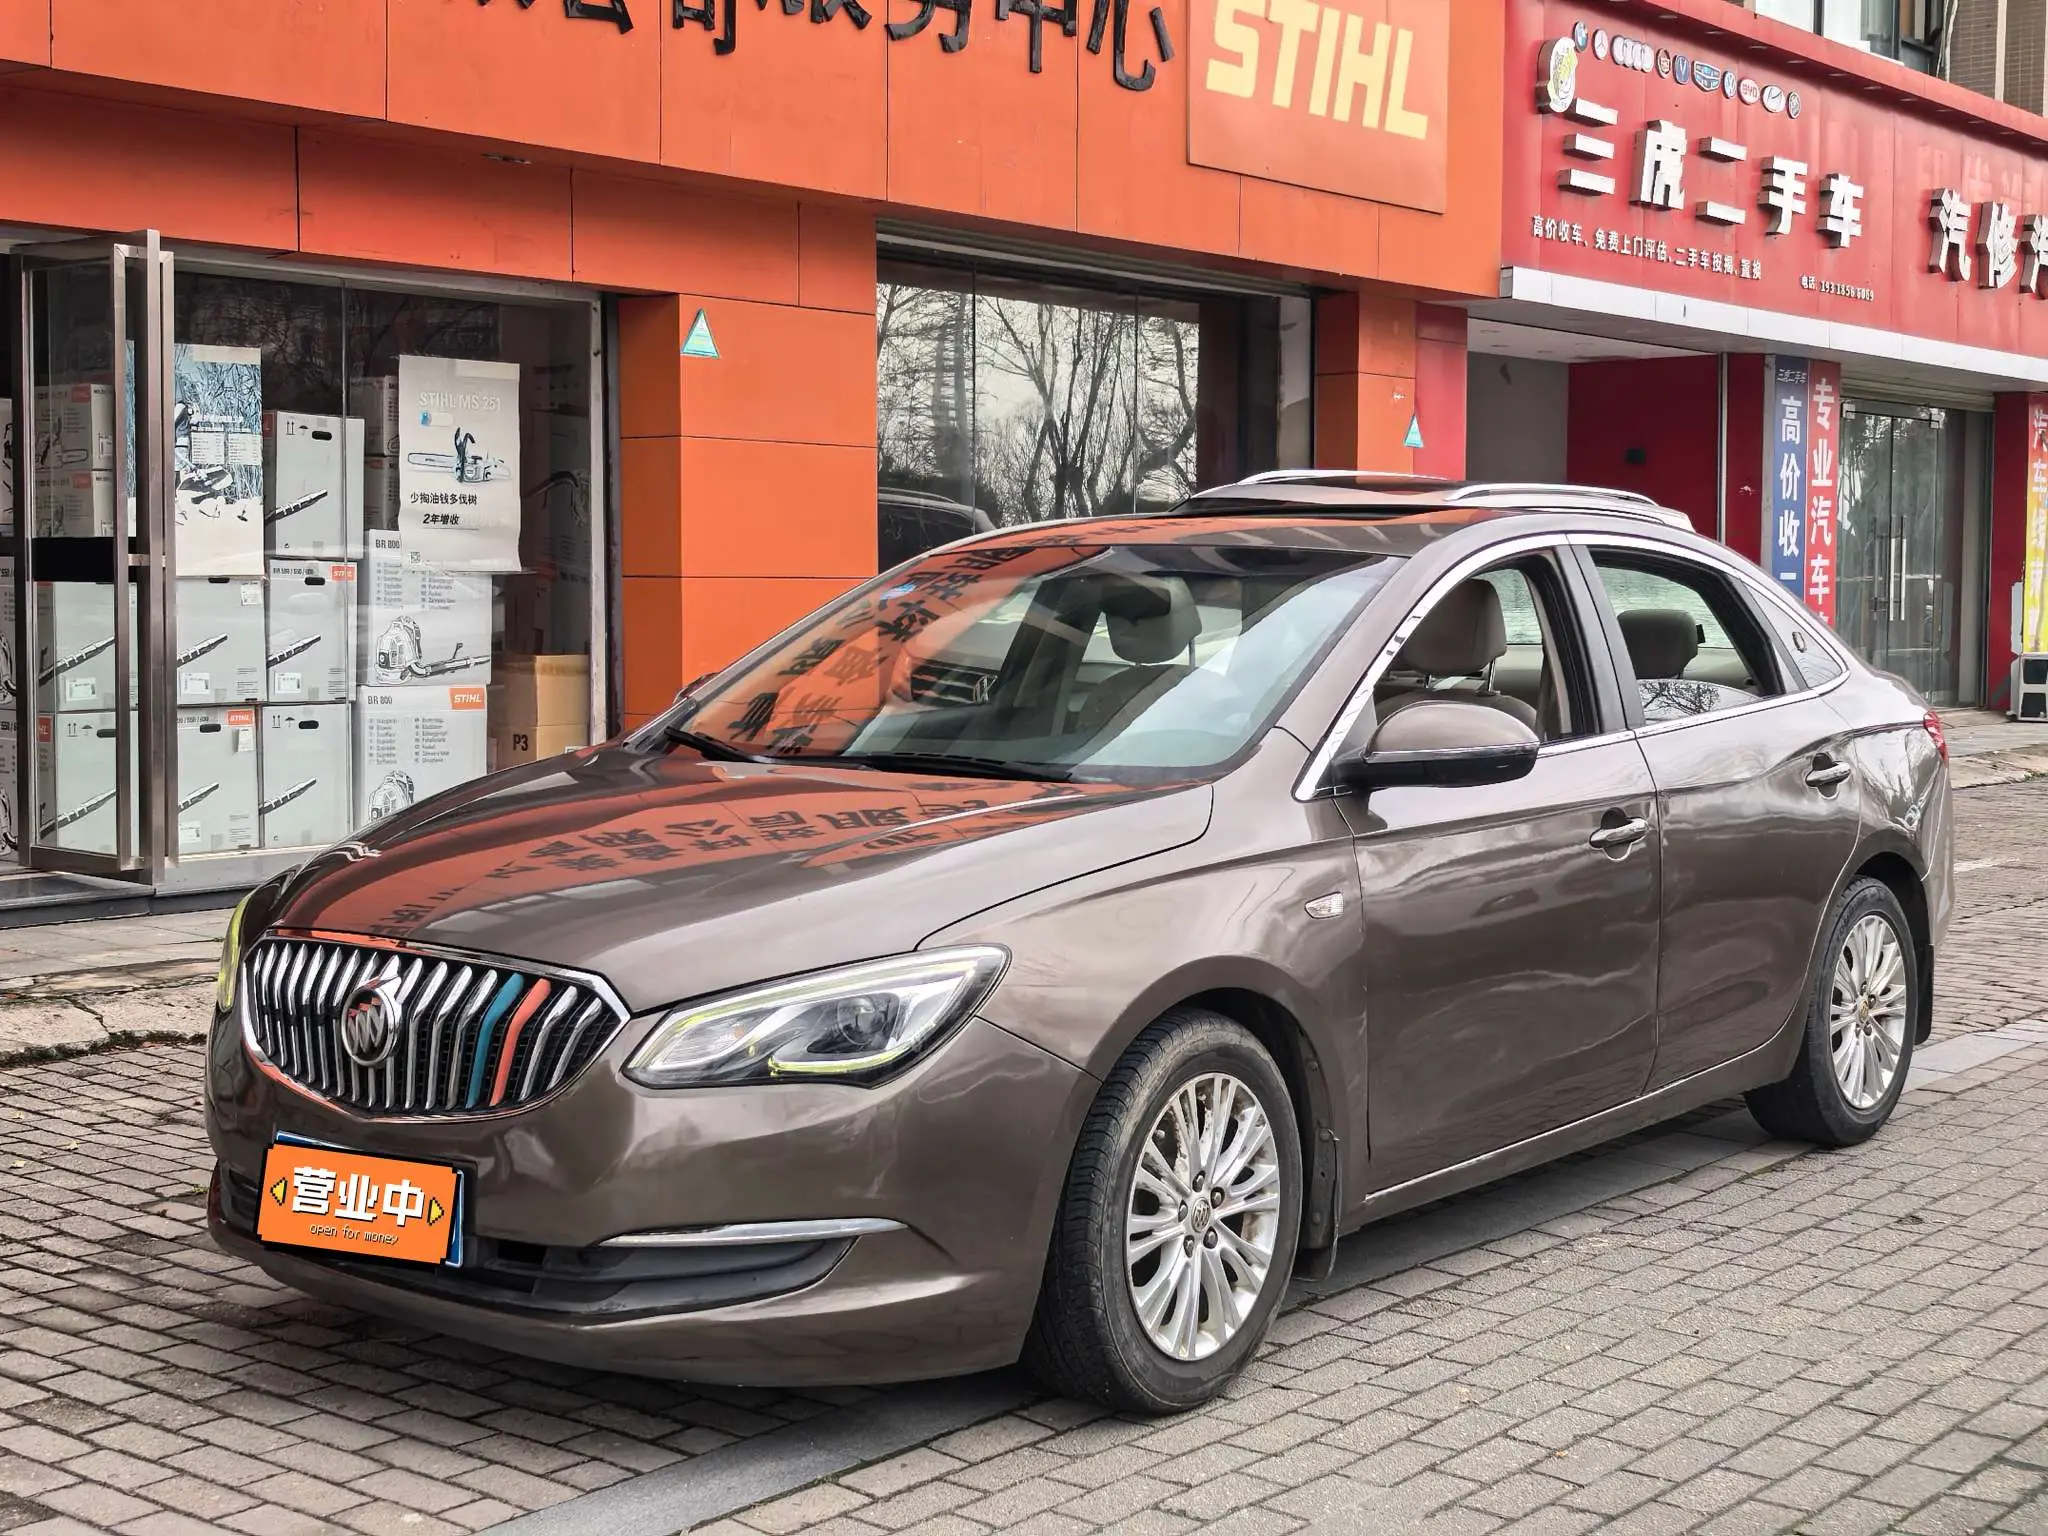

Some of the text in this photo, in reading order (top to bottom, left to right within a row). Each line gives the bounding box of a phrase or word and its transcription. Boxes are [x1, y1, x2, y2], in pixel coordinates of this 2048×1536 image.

[1206, 0, 1428, 140] STIHL
[1560, 97, 1864, 248] 三虎二手车
[419, 391, 457, 408] STIHL
[459, 394, 480, 410] MS
[410, 491, 478, 505] 少掏油钱多伐树
[1809, 378, 1834, 625] 专业汽车
[422, 513, 460, 526] 2年增收
[453, 693, 481, 704] STIHL
[512, 733, 529, 751] P3
